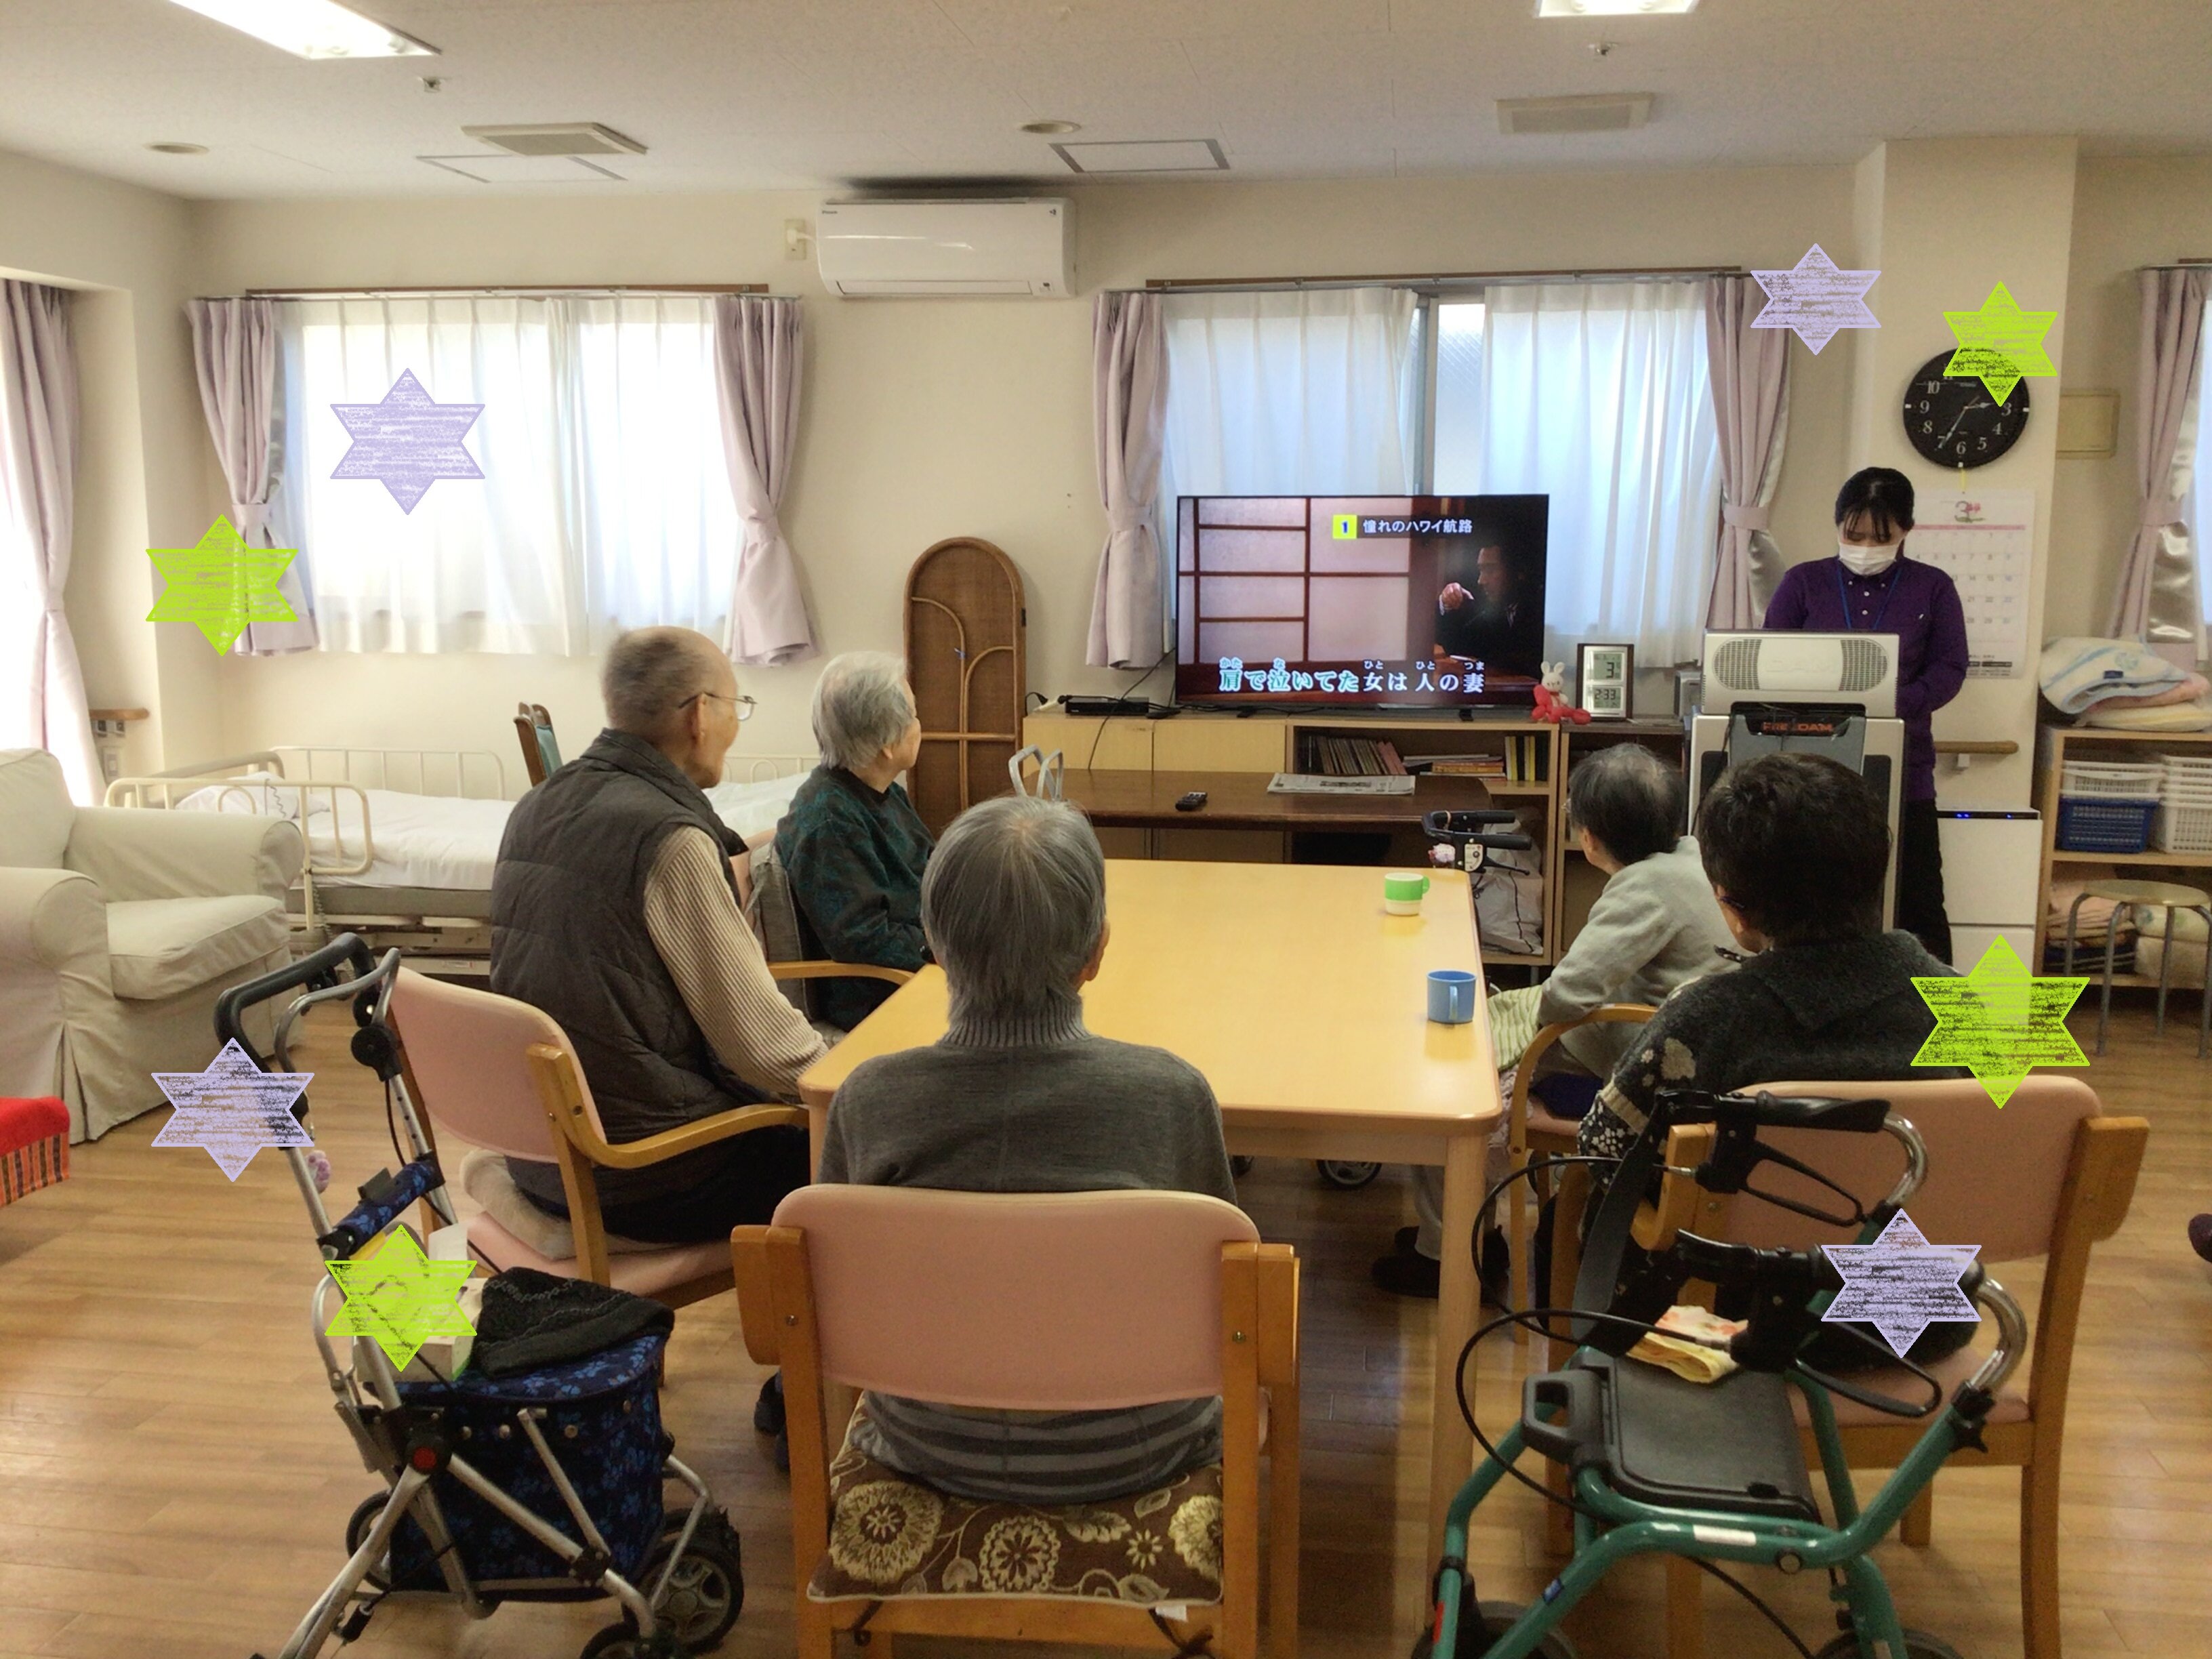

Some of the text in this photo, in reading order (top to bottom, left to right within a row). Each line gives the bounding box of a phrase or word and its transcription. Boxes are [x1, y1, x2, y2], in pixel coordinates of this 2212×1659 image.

[1927, 380, 1940, 394] 10
[1919, 401, 1930, 413] 9
[2001, 403, 2012, 416] 3
[1923, 421, 1933, 433] 8
[1992, 422, 2001, 435] 4
[1956, 441, 1966, 455] 6
[1977, 436, 1987, 450] 5
[1341, 519, 1473, 534] 1 憧れのハワイ航路
[1219, 657, 1243, 670] かた
[1364, 660, 1384, 670] ひと
[1416, 661, 1435, 670] ひと
[1465, 661, 1485, 670] つま
[1797, 722, 1834, 732] DAM
